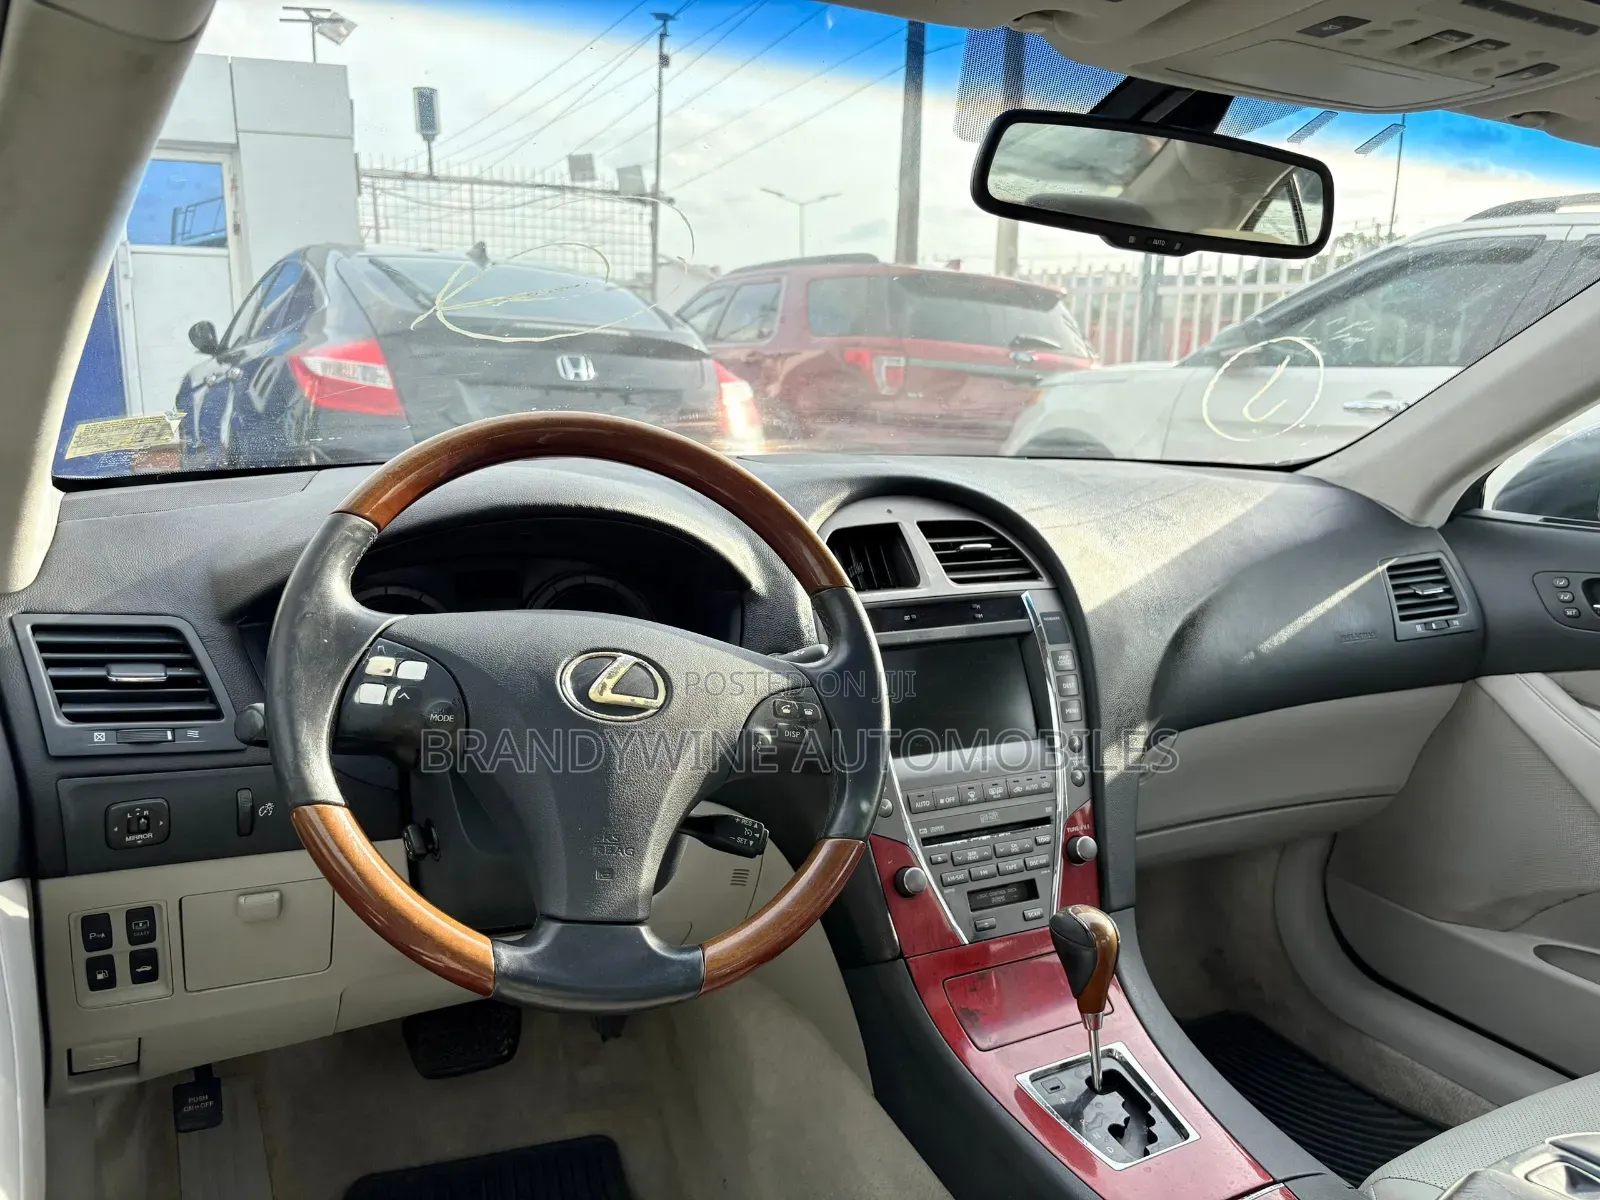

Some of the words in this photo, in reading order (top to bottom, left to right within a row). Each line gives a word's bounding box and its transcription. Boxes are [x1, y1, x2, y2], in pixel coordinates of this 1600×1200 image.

[1152, 238, 1166, 246] AUTO
[429, 713, 455, 723] MODE
[784, 729, 801, 739] DISP
[915, 800, 931, 809] AUTO
[945, 796, 956, 804] OFF
[125, 832, 154, 843] MIRROR
[1005, 862, 1018, 871] TAPE
[188, 1094, 209, 1104] PUSH
